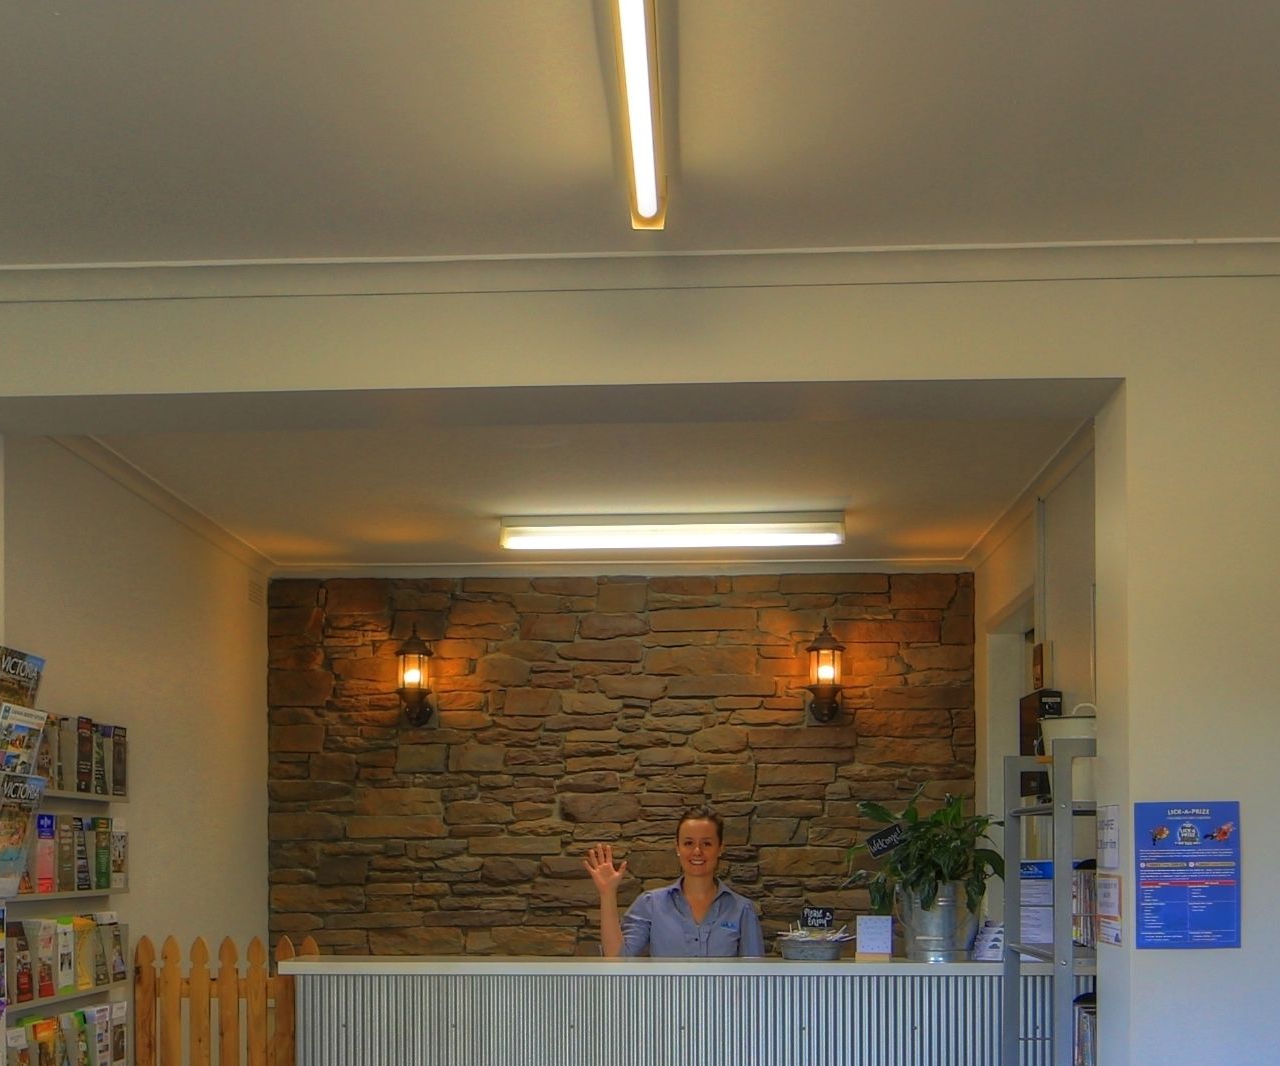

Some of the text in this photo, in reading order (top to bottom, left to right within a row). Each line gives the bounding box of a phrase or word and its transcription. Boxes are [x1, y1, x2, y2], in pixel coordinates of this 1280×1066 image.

[1, 654, 39, 680] VICTORIA
[3, 781, 41, 802] VICTORIA
[868, 826, 901, 853] Welcome!
